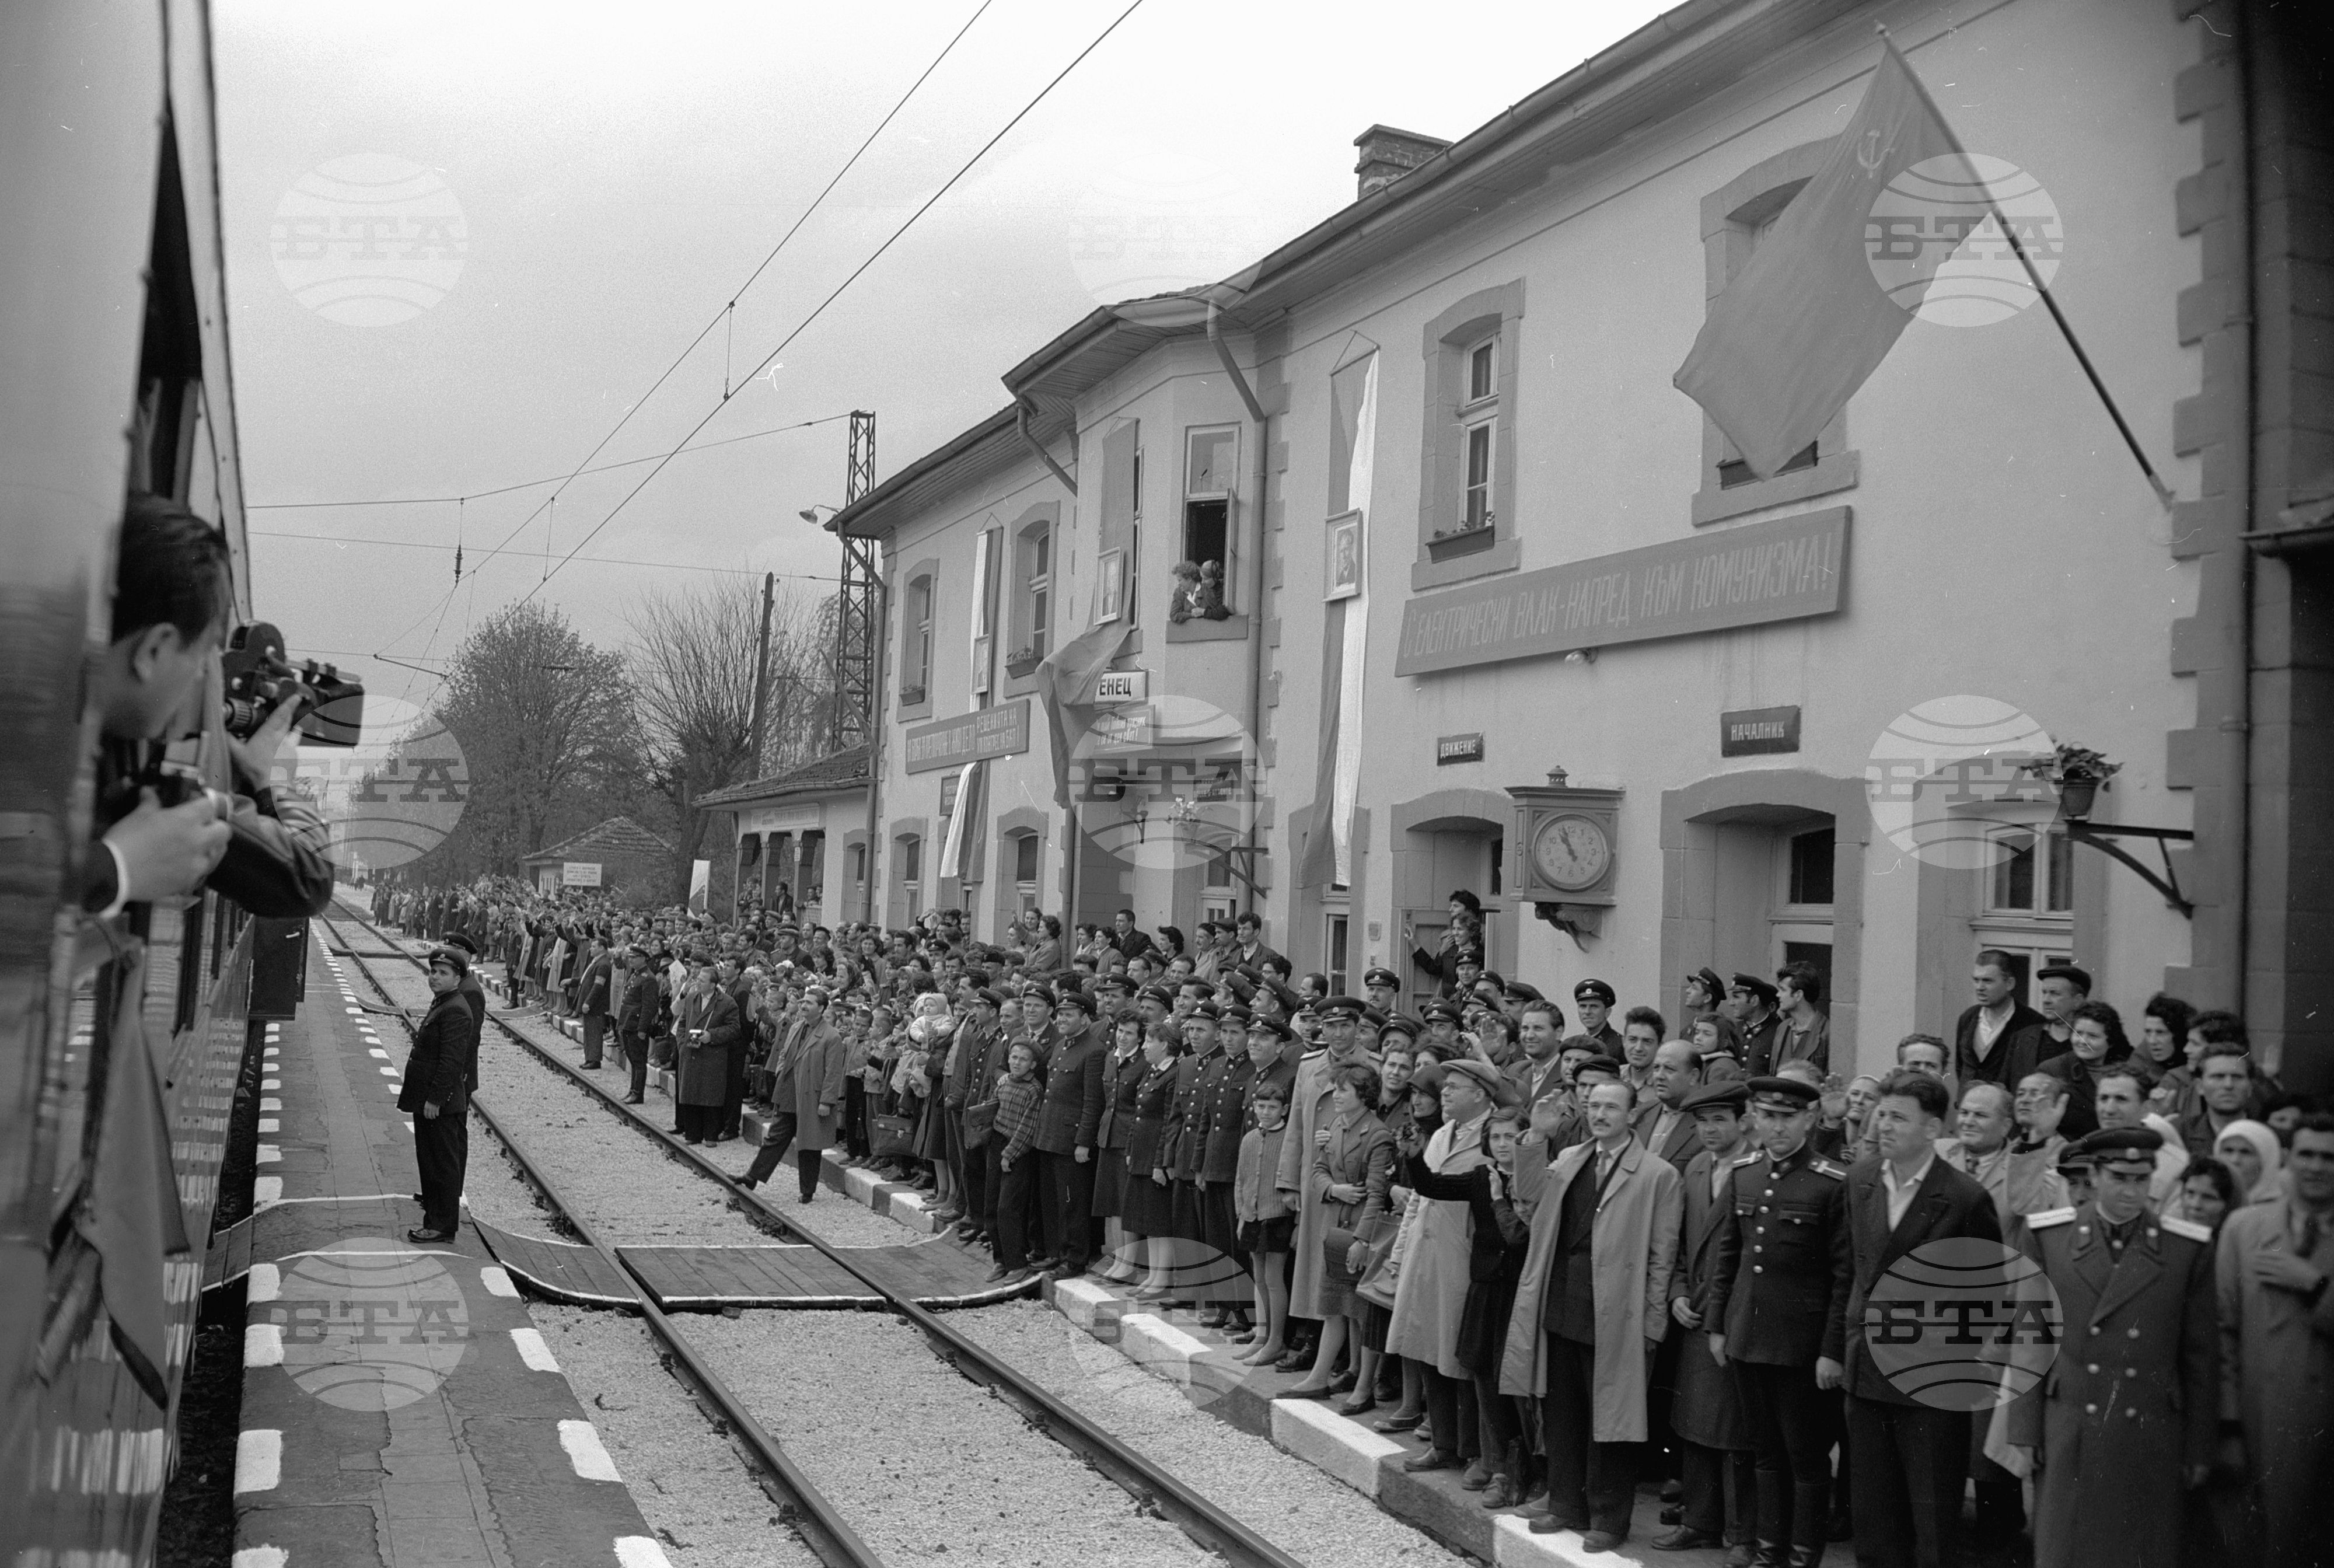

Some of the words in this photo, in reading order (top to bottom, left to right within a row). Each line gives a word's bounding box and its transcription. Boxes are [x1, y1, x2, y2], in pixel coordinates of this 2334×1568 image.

[1403, 606, 1415, 658] С
[1417, 599, 1508, 654] ЕЛЕКТРИЧЕСКИ
[1641, 561, 1685, 616] КЪМ
[1692, 533, 1833, 606] КОМУНИЗМА!
[1730, 720, 1786, 742] НАЧАЛНИК
[1439, 738, 1476, 760] ДВИЖЕНИЕ
[1557, 867, 1563, 875] 7
